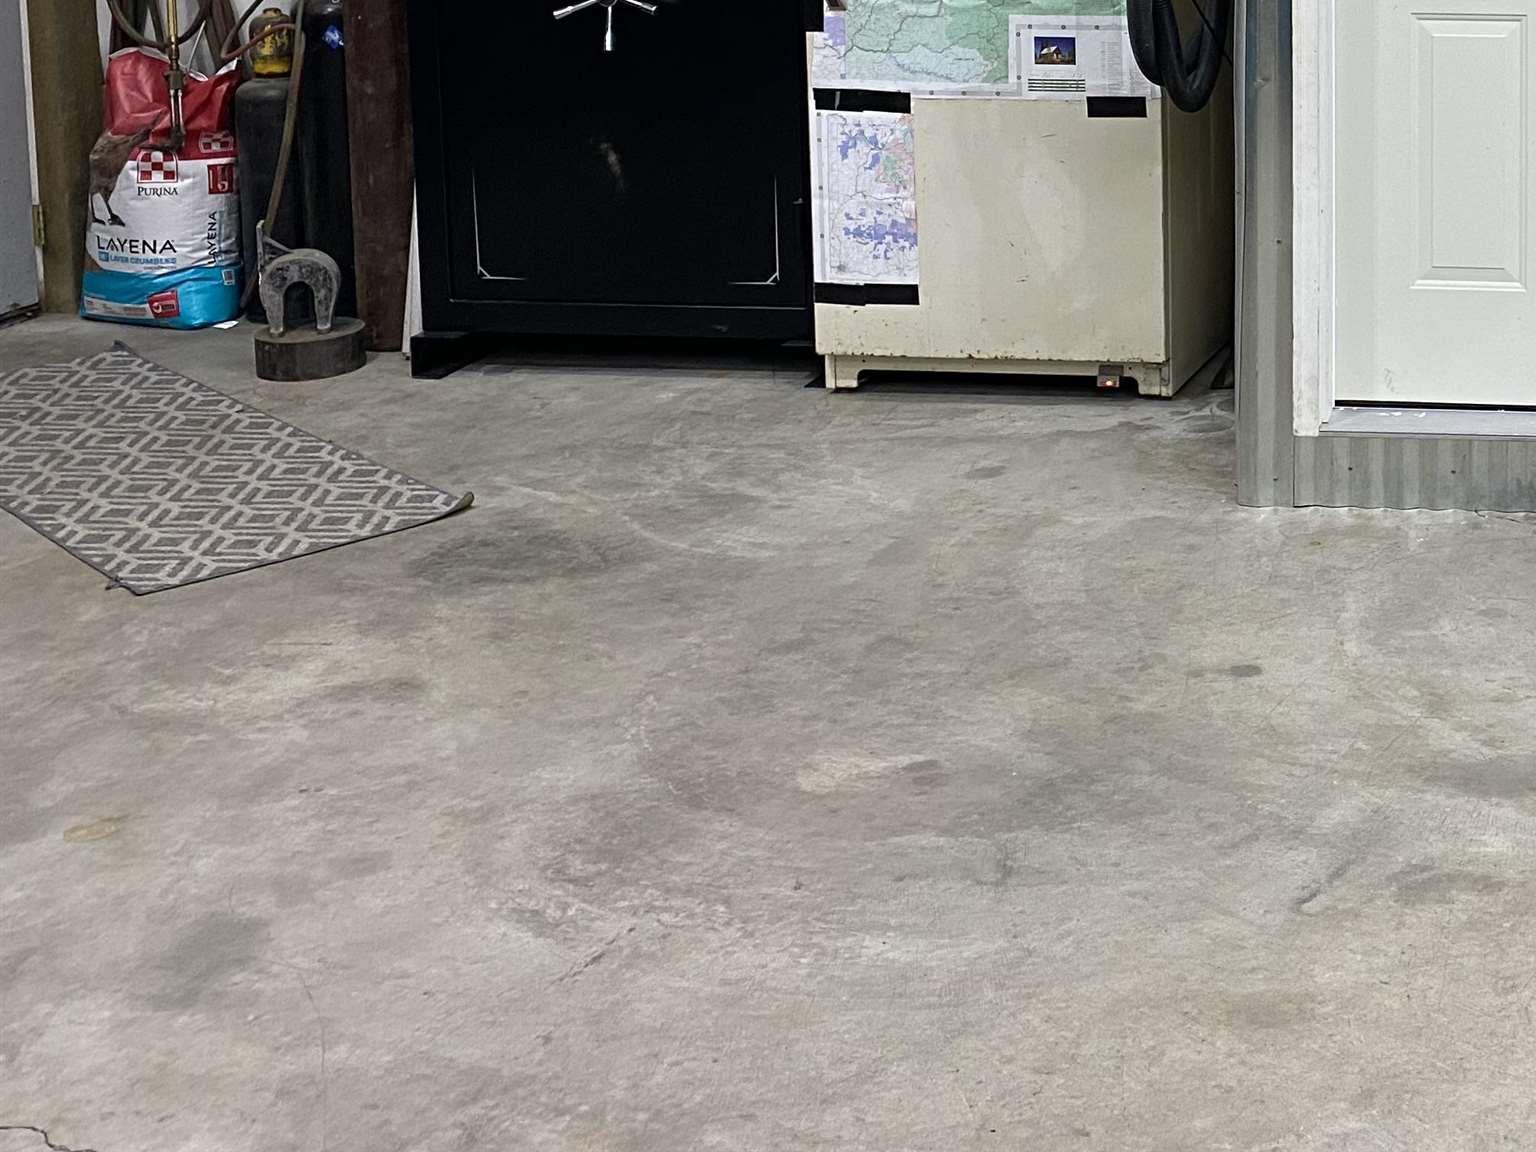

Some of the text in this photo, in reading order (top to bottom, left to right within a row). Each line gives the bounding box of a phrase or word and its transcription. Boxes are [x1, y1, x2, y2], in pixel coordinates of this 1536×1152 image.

[137, 186, 178, 196] PURINA
[97, 236, 177, 254] LAYENA
[207, 210, 217, 264] LAYENA
